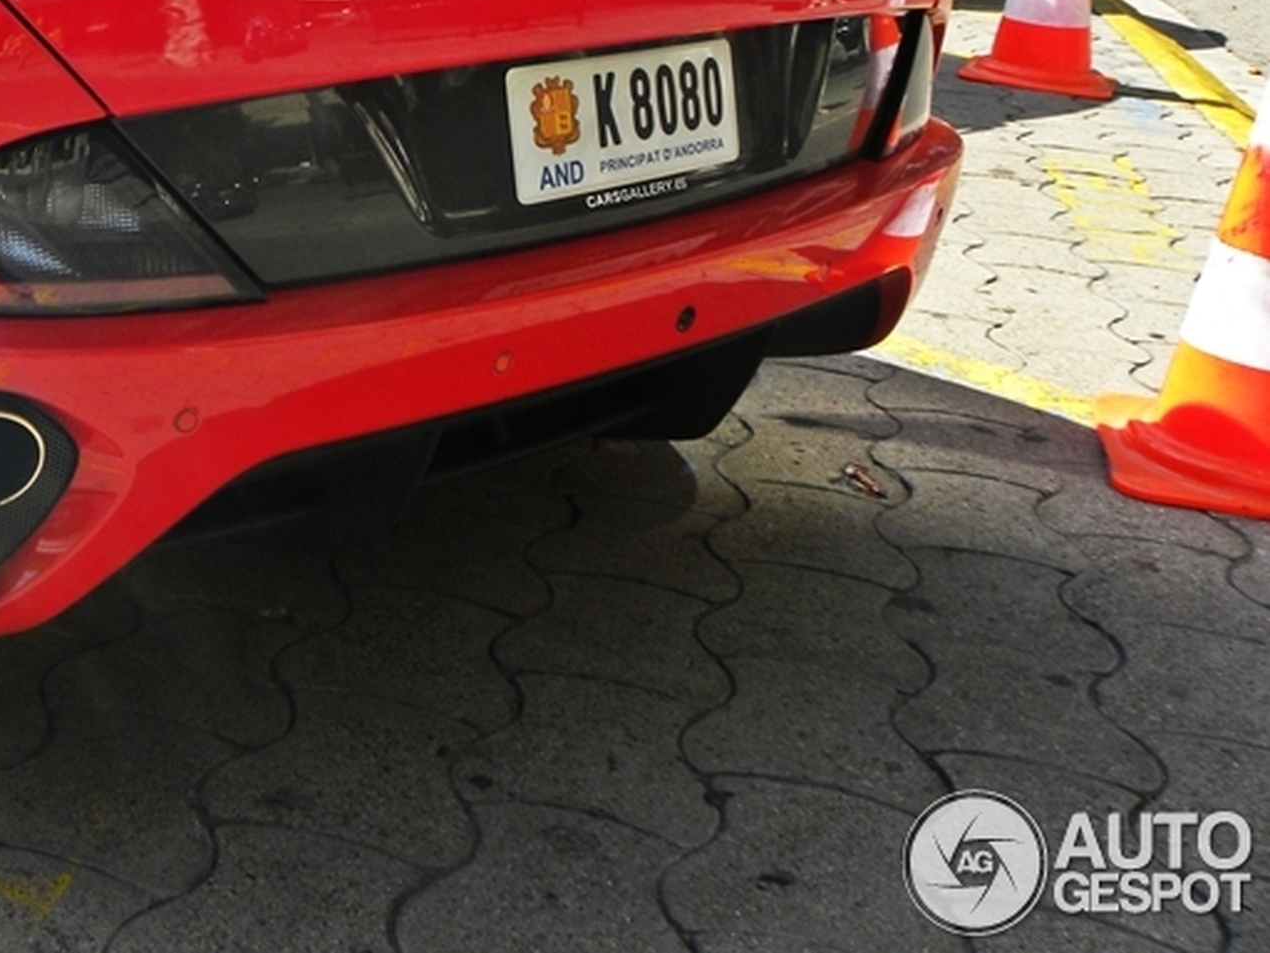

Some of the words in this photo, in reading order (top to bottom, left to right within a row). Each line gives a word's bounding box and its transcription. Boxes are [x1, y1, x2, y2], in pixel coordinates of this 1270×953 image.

[593, 71, 622, 148] K
[630, 57, 723, 140] 8080
[599, 149, 661, 174] PRINCIPAT
[662, 138, 725, 162] D'ANDORRA
[539, 160, 585, 190] AND
